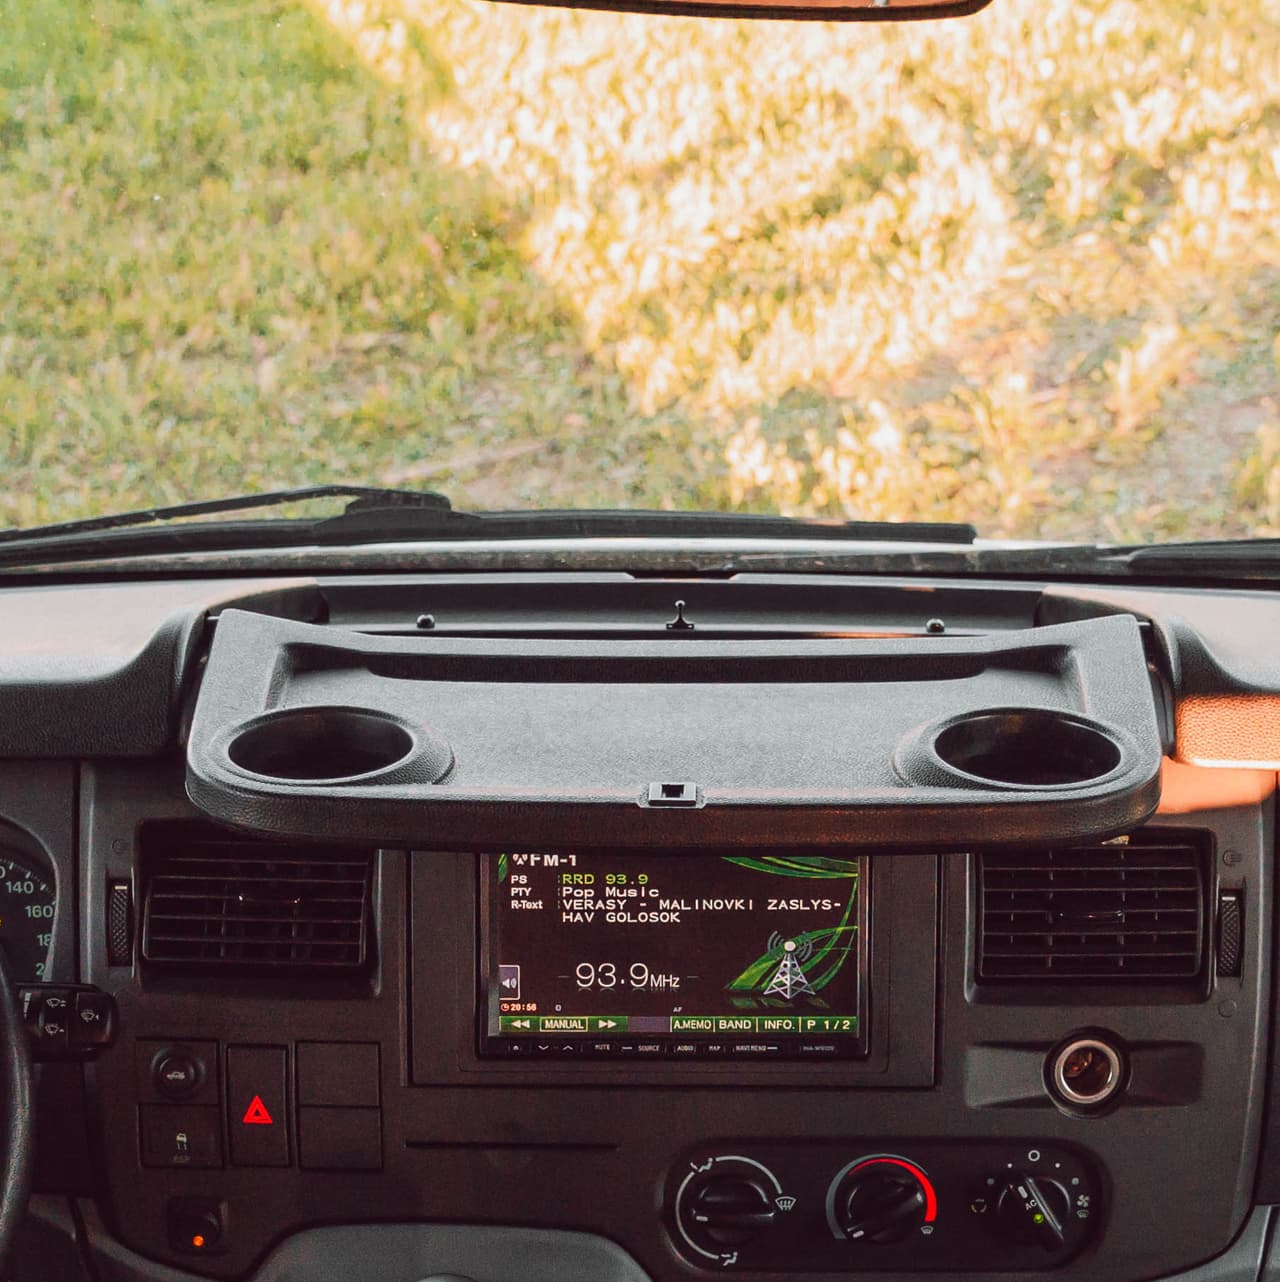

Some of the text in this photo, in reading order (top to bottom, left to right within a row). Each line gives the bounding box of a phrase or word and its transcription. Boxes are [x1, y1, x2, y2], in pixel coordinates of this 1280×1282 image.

[530, 854, 577, 866] FM-1
[511, 875, 528, 884] PS
[562, 874, 648, 885] RRD 93.9
[5, 881, 34, 895] 140
[511, 887, 532, 897] PTY
[562, 886, 659, 900] Pop Music
[511, 900, 543, 910] R-Text
[562, 899, 626, 910] VERASY
[659, 899, 753, 910] MALINOVKI
[767, 899, 841, 910] ZASLYS-
[24, 905, 53, 919] 160
[562, 912, 681, 923] HAV GOLOSOK
[37, 933, 51, 946] 18
[576, 962, 680, 988] 93.9 MHz
[544, 1019, 585, 1030] MANUAL
[673, 1019, 712, 1030] A.MEMO
[718, 1019, 752, 1030] BAND
[764, 1019, 796, 1030] INFO.
[807, 1020, 816, 1030] P
